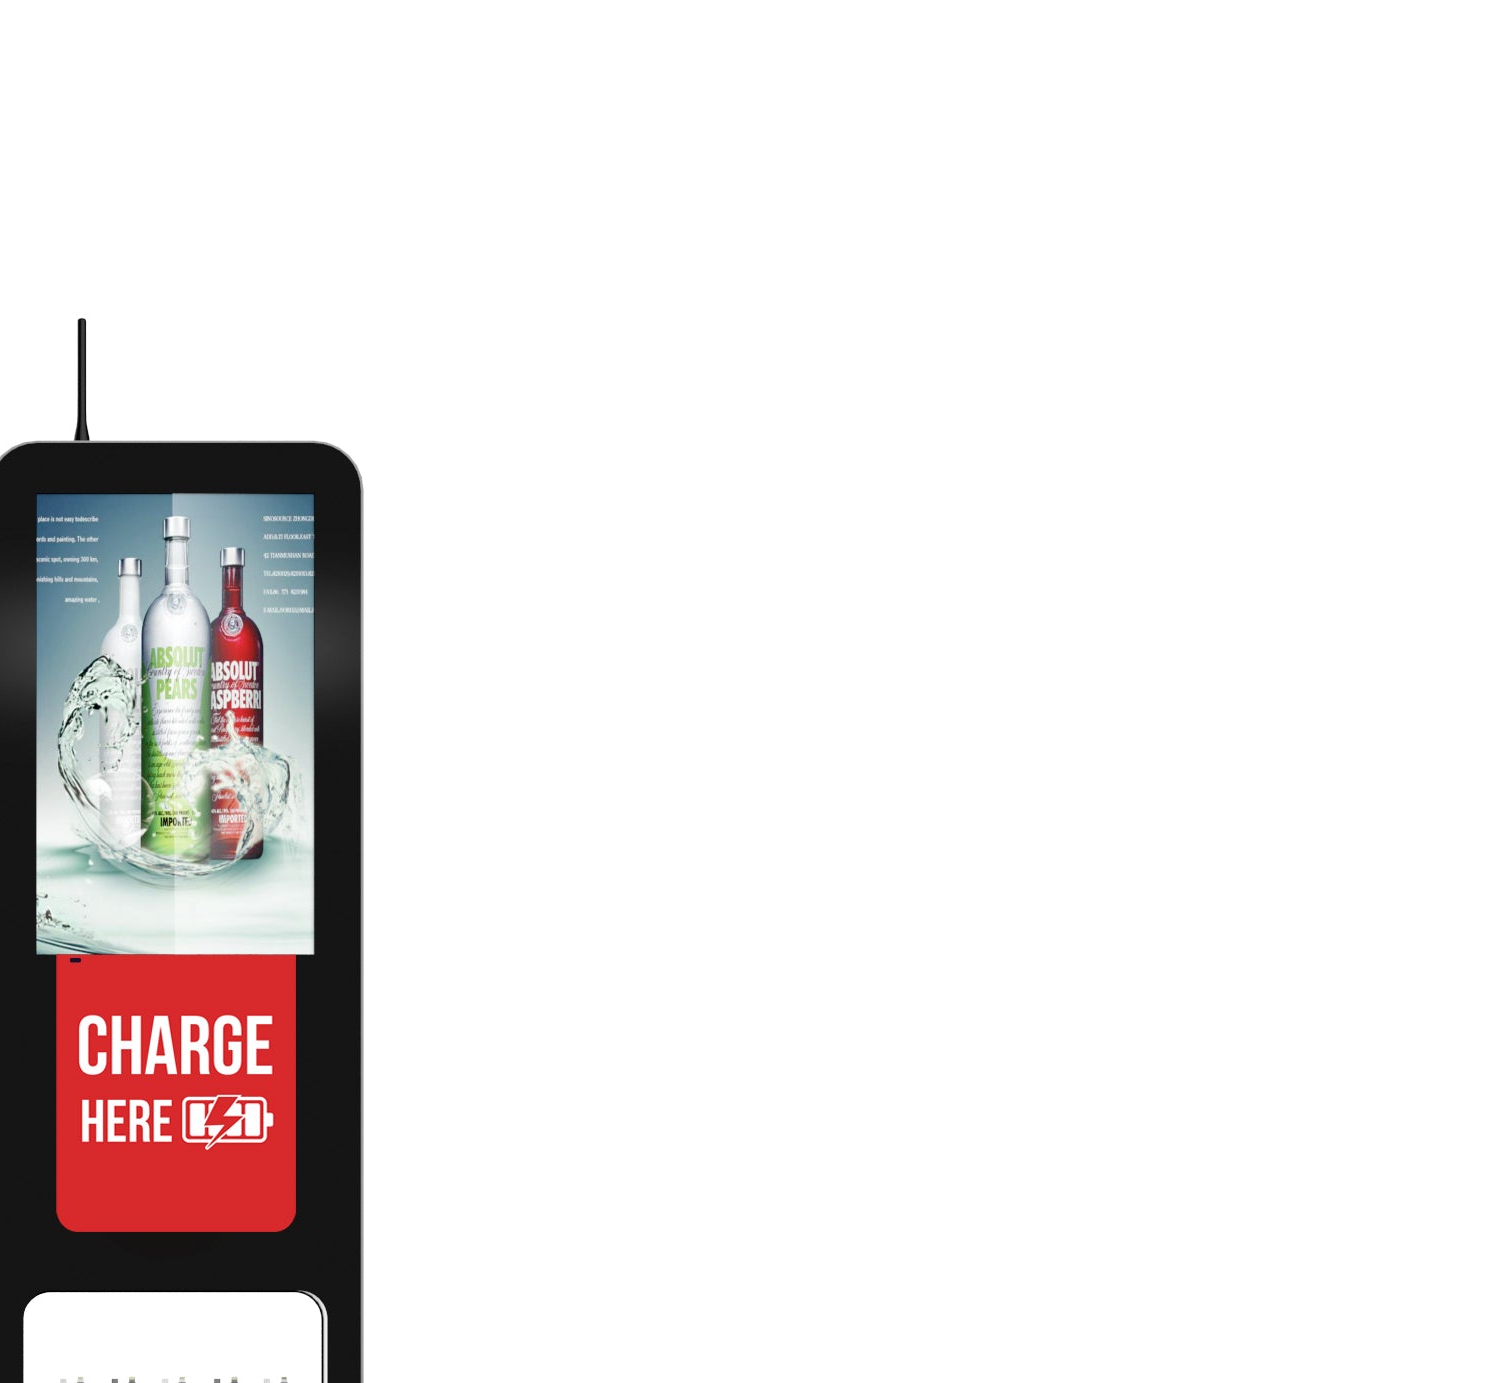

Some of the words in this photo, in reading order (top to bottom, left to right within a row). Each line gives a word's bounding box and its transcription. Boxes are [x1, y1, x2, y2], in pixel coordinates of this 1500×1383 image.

[37, 515, 50, 523] place
[149, 646, 204, 669] ABSOLUT
[211, 661, 259, 681] ABSOLUT
[156, 678, 197, 700] PEARS
[78, 1014, 273, 1076] CHARGE
[81, 1099, 173, 1143] HERE
